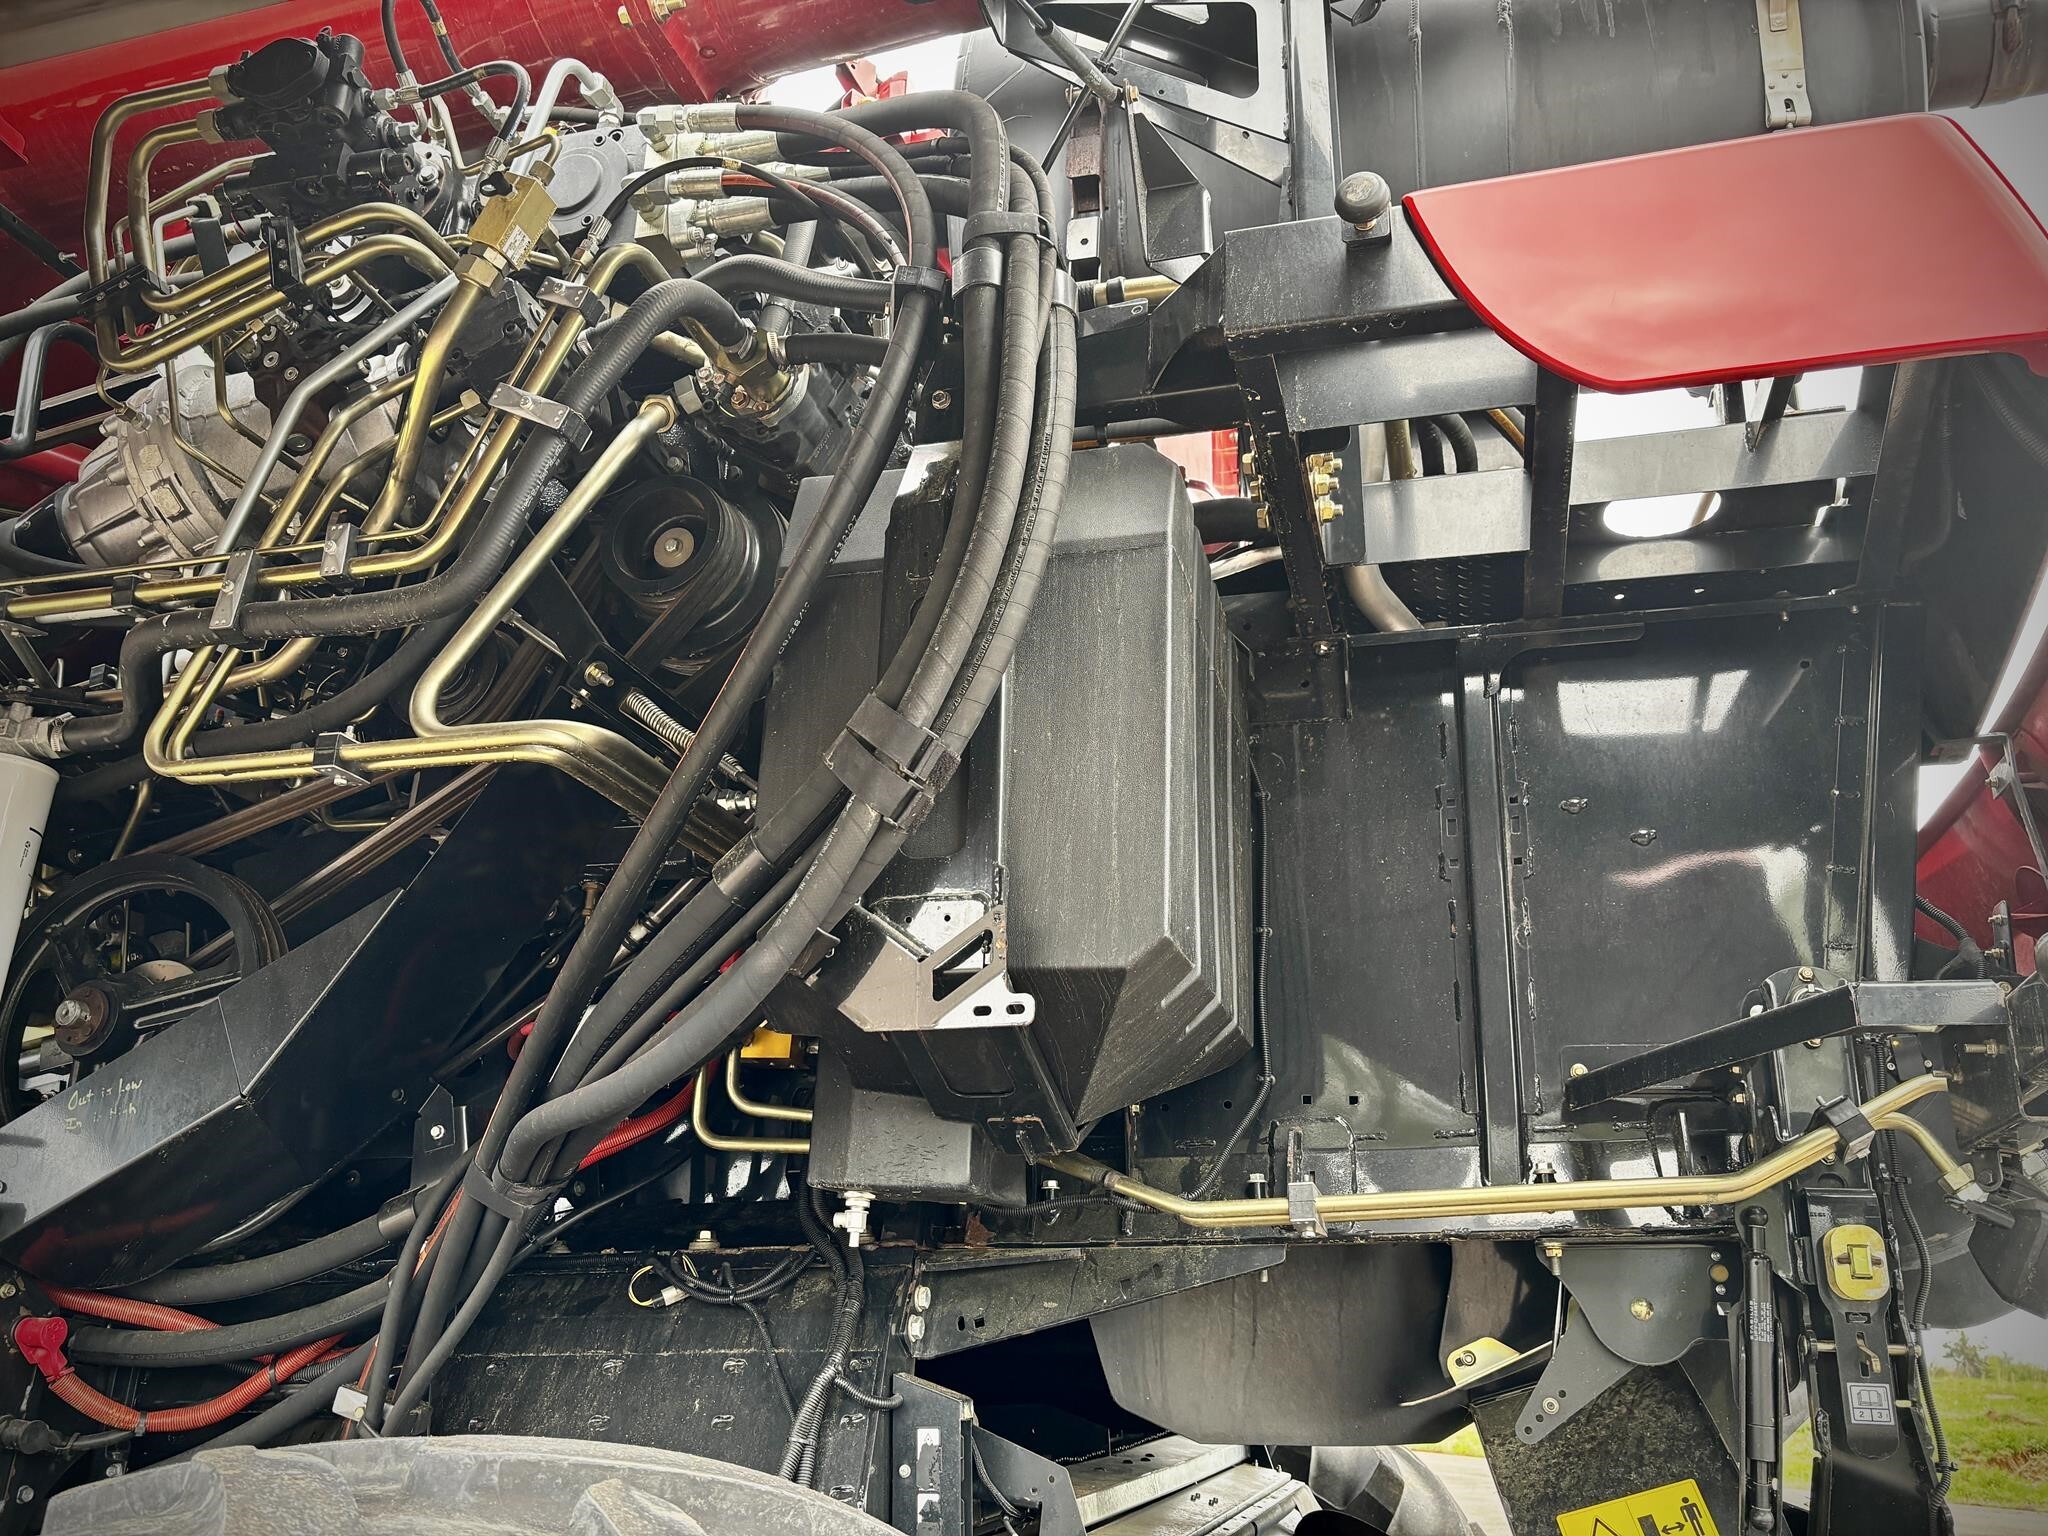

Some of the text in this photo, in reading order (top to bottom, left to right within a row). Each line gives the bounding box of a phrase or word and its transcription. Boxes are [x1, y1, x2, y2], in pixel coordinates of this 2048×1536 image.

[68, 1078, 143, 1110] Out is Low
[1877, 1411, 1883, 1419] 3
